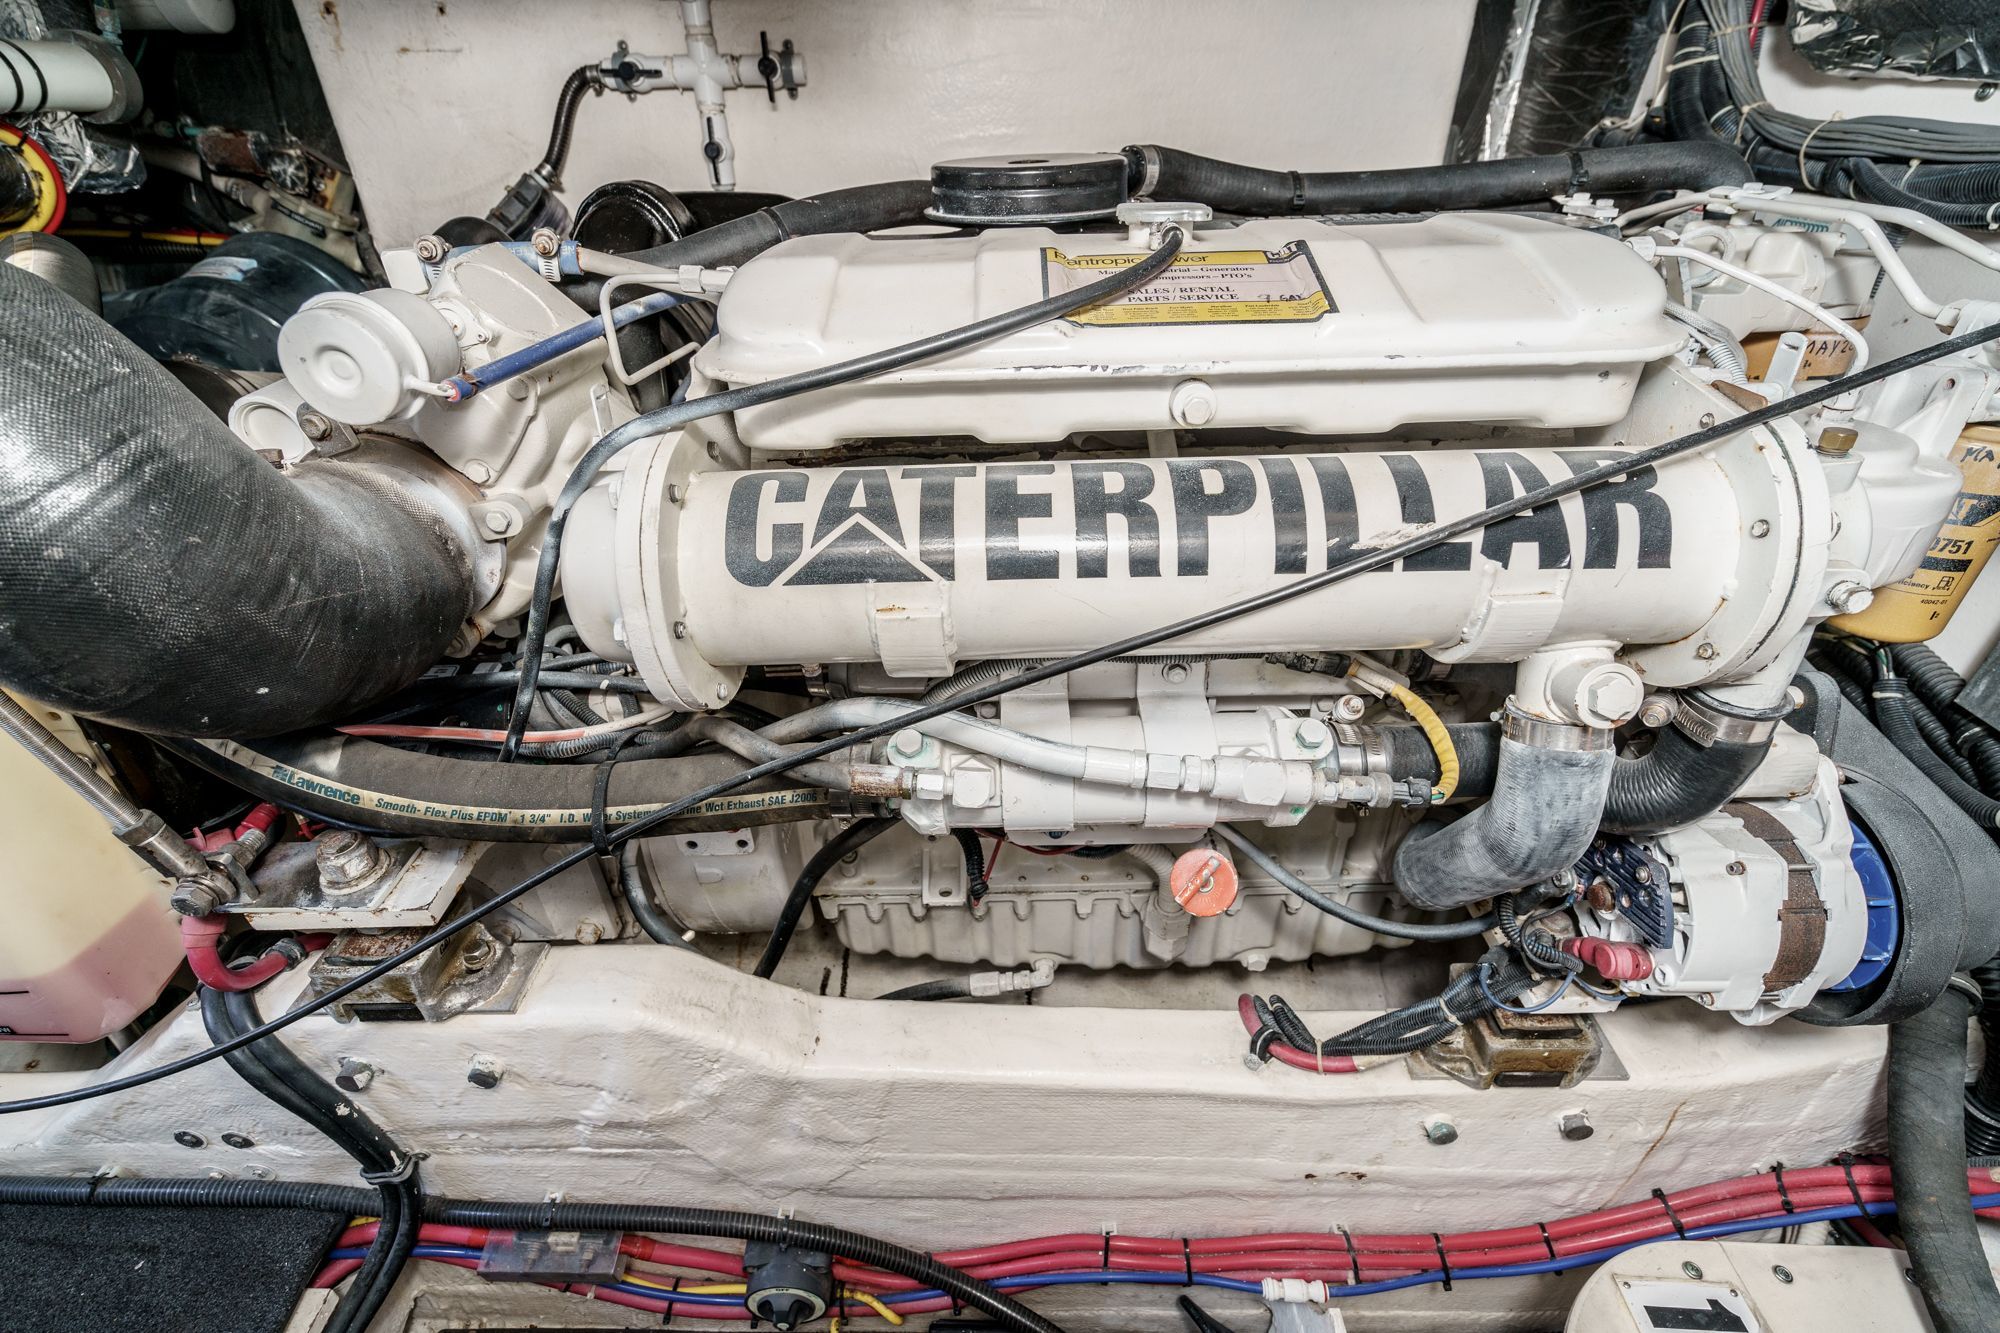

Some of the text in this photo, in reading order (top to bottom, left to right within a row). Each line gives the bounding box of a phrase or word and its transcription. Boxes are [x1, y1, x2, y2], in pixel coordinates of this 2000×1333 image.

[1174, 254, 1210, 263] wer
[1127, 287, 1170, 295] SALES
[1179, 285, 1235, 293] RENTAL
[1127, 295, 1170, 303] PARTS
[1179, 293, 1240, 301] SERVICE
[725, 450, 1672, 587] CATERPILLAR
[287, 768, 361, 805] Lawrence
[424, 806, 447, 819] Flex
[450, 809, 474, 820] Plus
[583, 812, 612, 823] Wer
[727, 798, 766, 811] Exhaust
[768, 795, 787, 806] SAE
[789, 792, 818, 804] J2006
